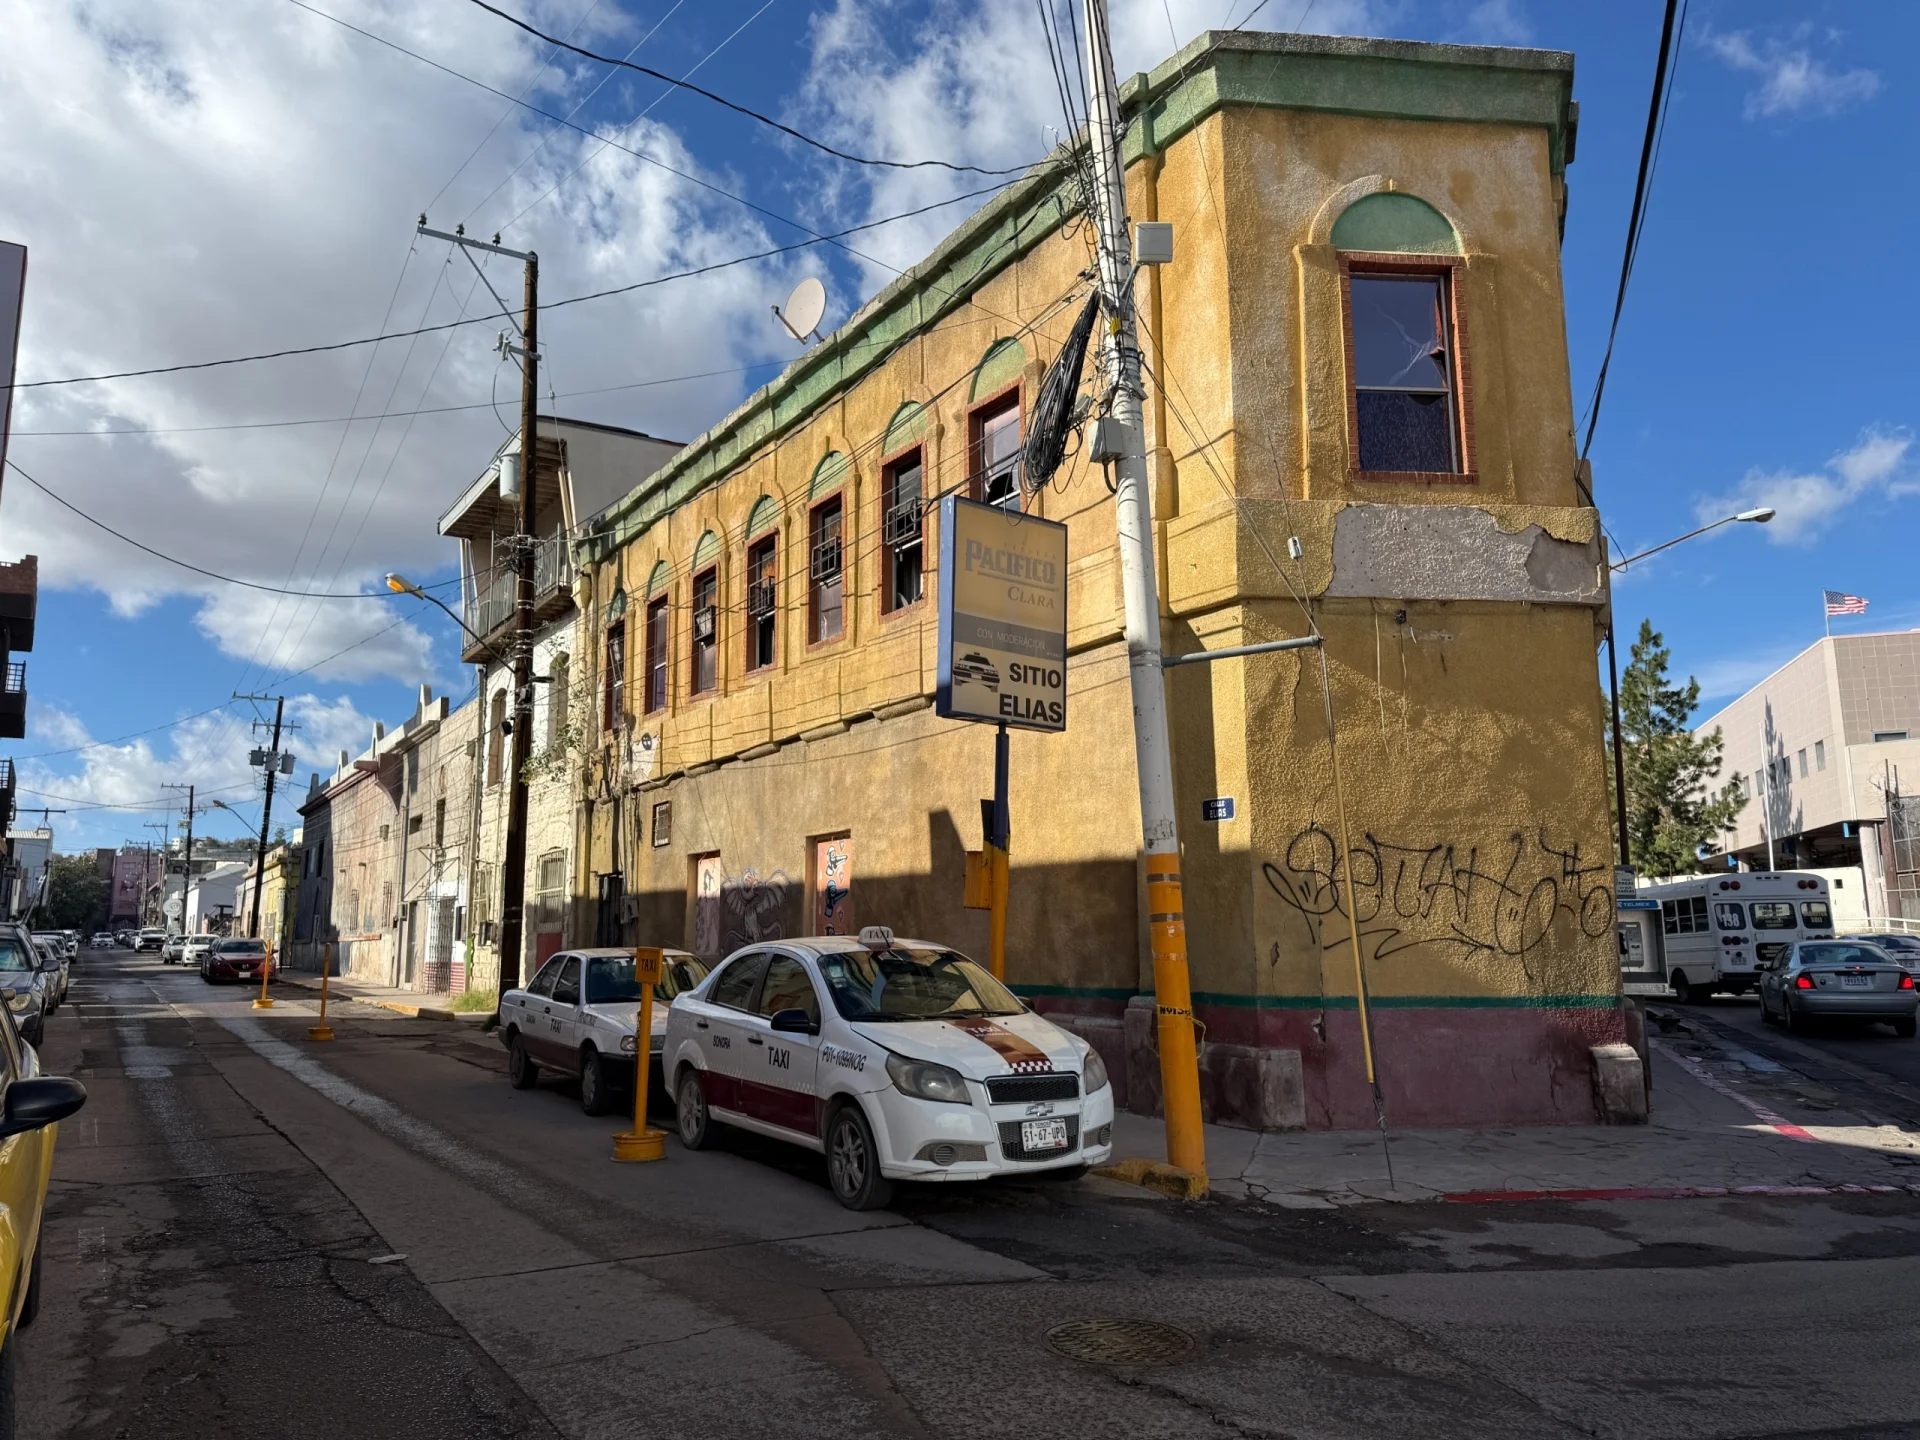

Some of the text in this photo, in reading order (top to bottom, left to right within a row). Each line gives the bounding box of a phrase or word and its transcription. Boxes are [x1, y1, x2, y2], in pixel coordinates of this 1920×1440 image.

[965, 538, 1056, 585] PACIFICO
[977, 627, 993, 640] CON
[1009, 662, 1062, 689] SITIO
[999, 693, 1063, 724] ELIAS
[1721, 913, 1740, 928] 138
[868, 930, 890, 939] TAXI
[641, 958, 657, 973] TAXI
[550, 1017, 562, 1034] TAXI
[712, 1035, 731, 1050] SONORA
[767, 1046, 790, 1070] TAXI
